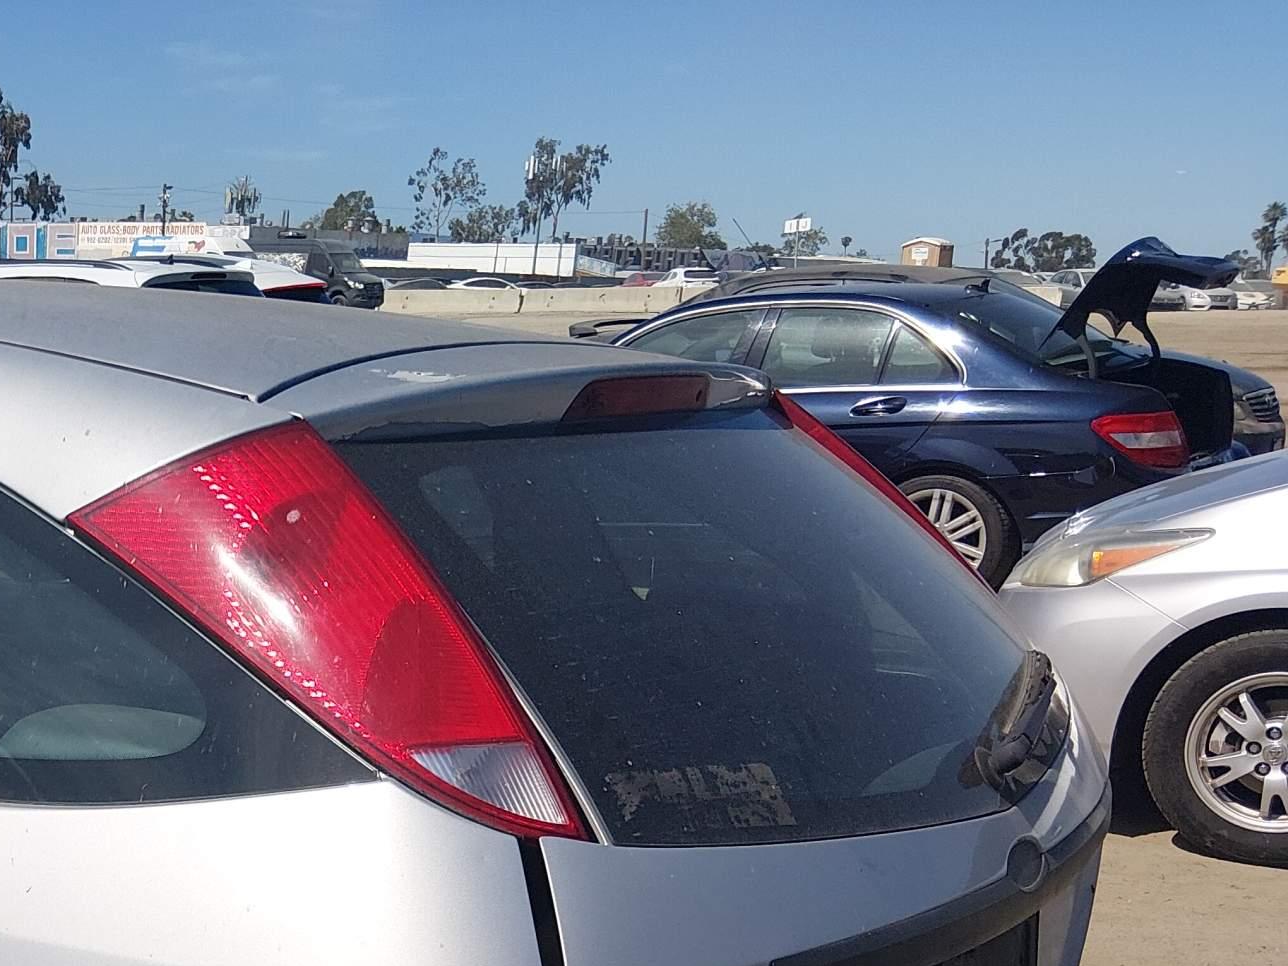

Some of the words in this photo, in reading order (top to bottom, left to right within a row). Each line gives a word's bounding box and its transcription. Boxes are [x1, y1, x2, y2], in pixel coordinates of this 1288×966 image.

[81, 225, 97, 235] AUTO
[143, 225, 162, 235] PARTS
[166, 225, 204, 235] RADIATORS
